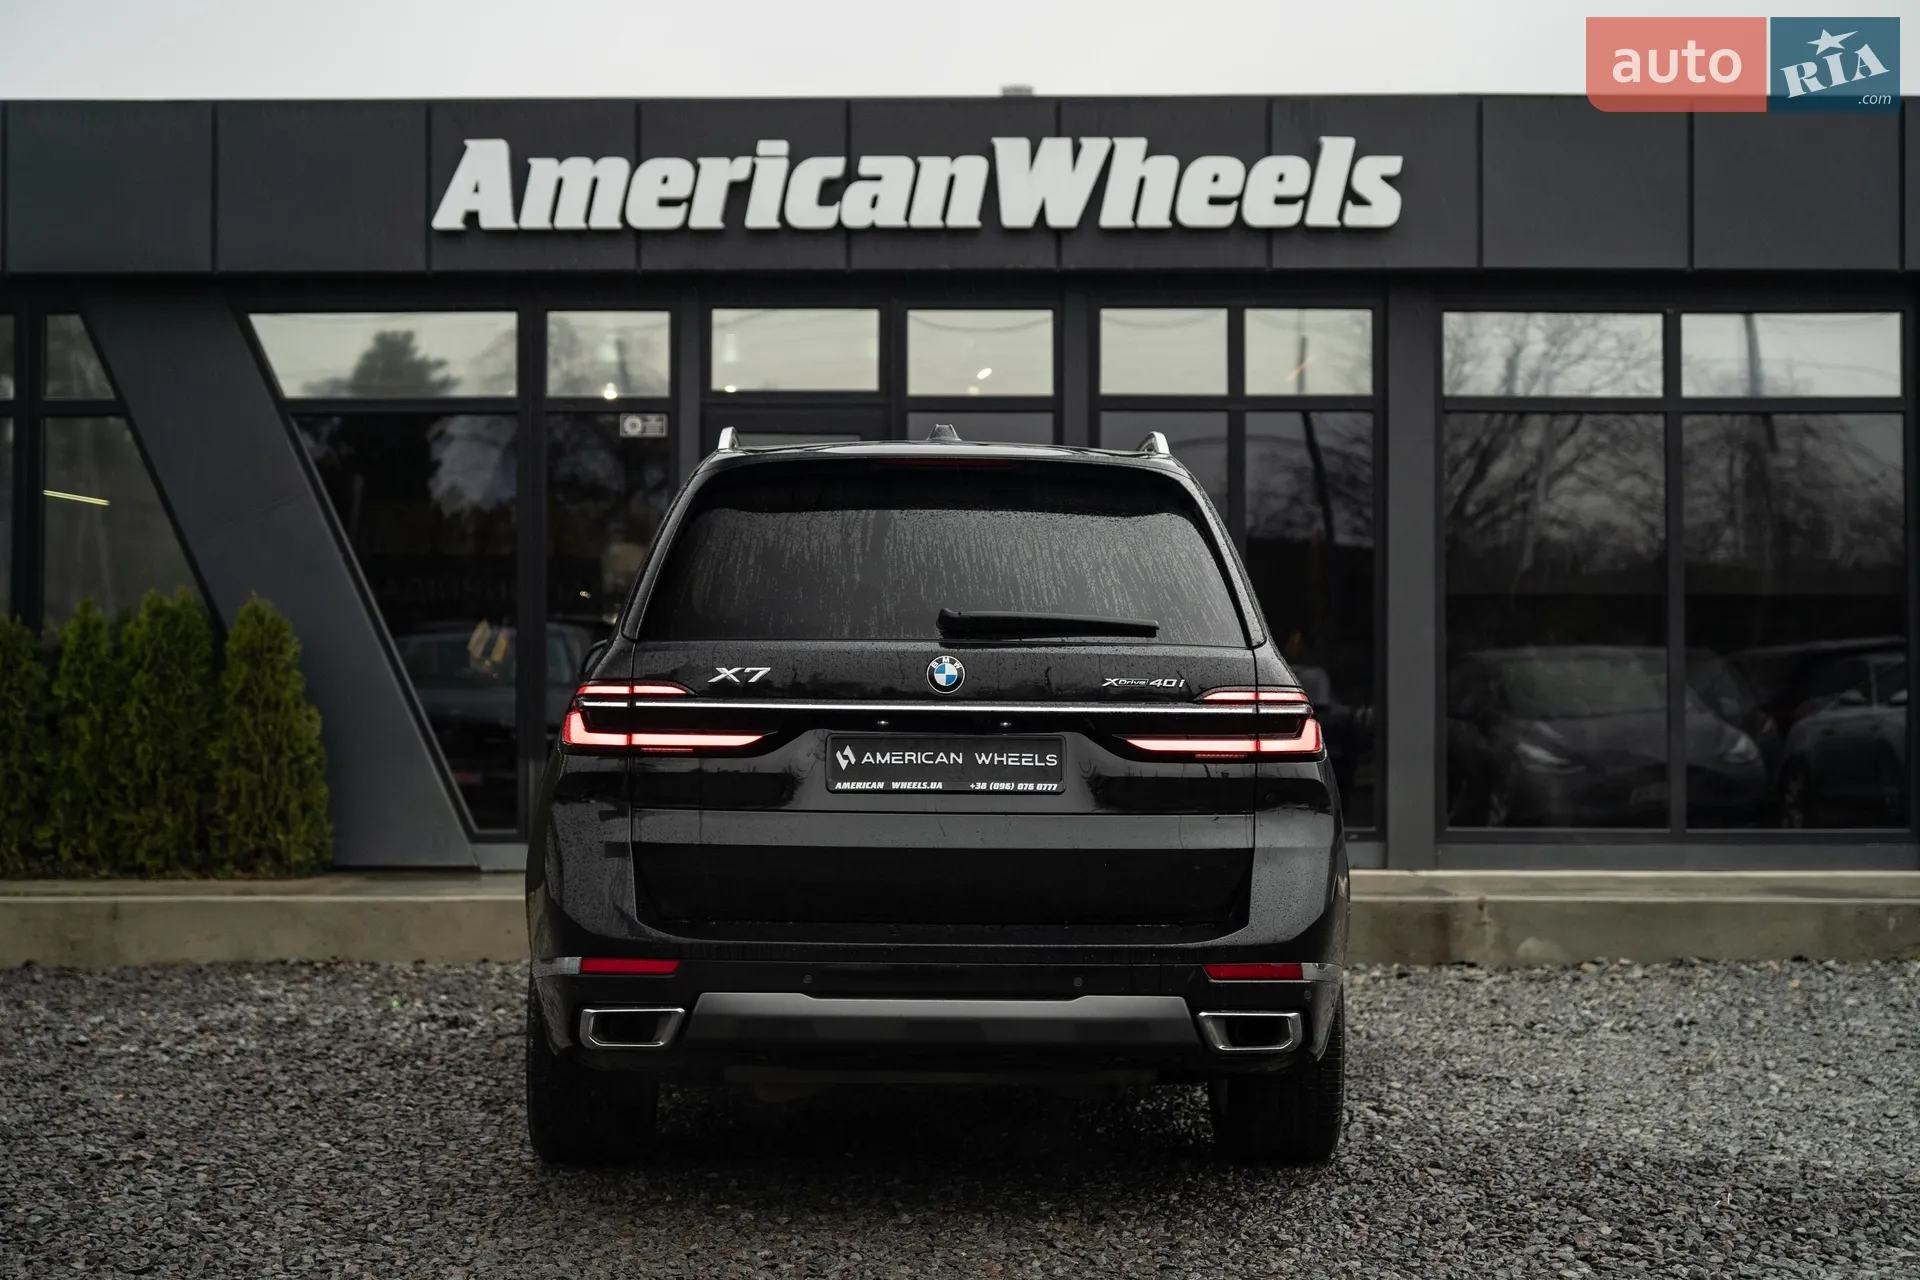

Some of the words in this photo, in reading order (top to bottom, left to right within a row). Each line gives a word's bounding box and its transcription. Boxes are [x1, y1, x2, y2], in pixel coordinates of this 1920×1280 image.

[930, 656, 962, 669] BMW
[707, 667, 771, 683] X7
[861, 752, 963, 764] AMERICAN
[974, 752, 1058, 766] WHEELS
[969, 782, 987, 790] +38
[989, 782, 1014, 791] (096)
[1036, 783, 1058, 791] 0777
